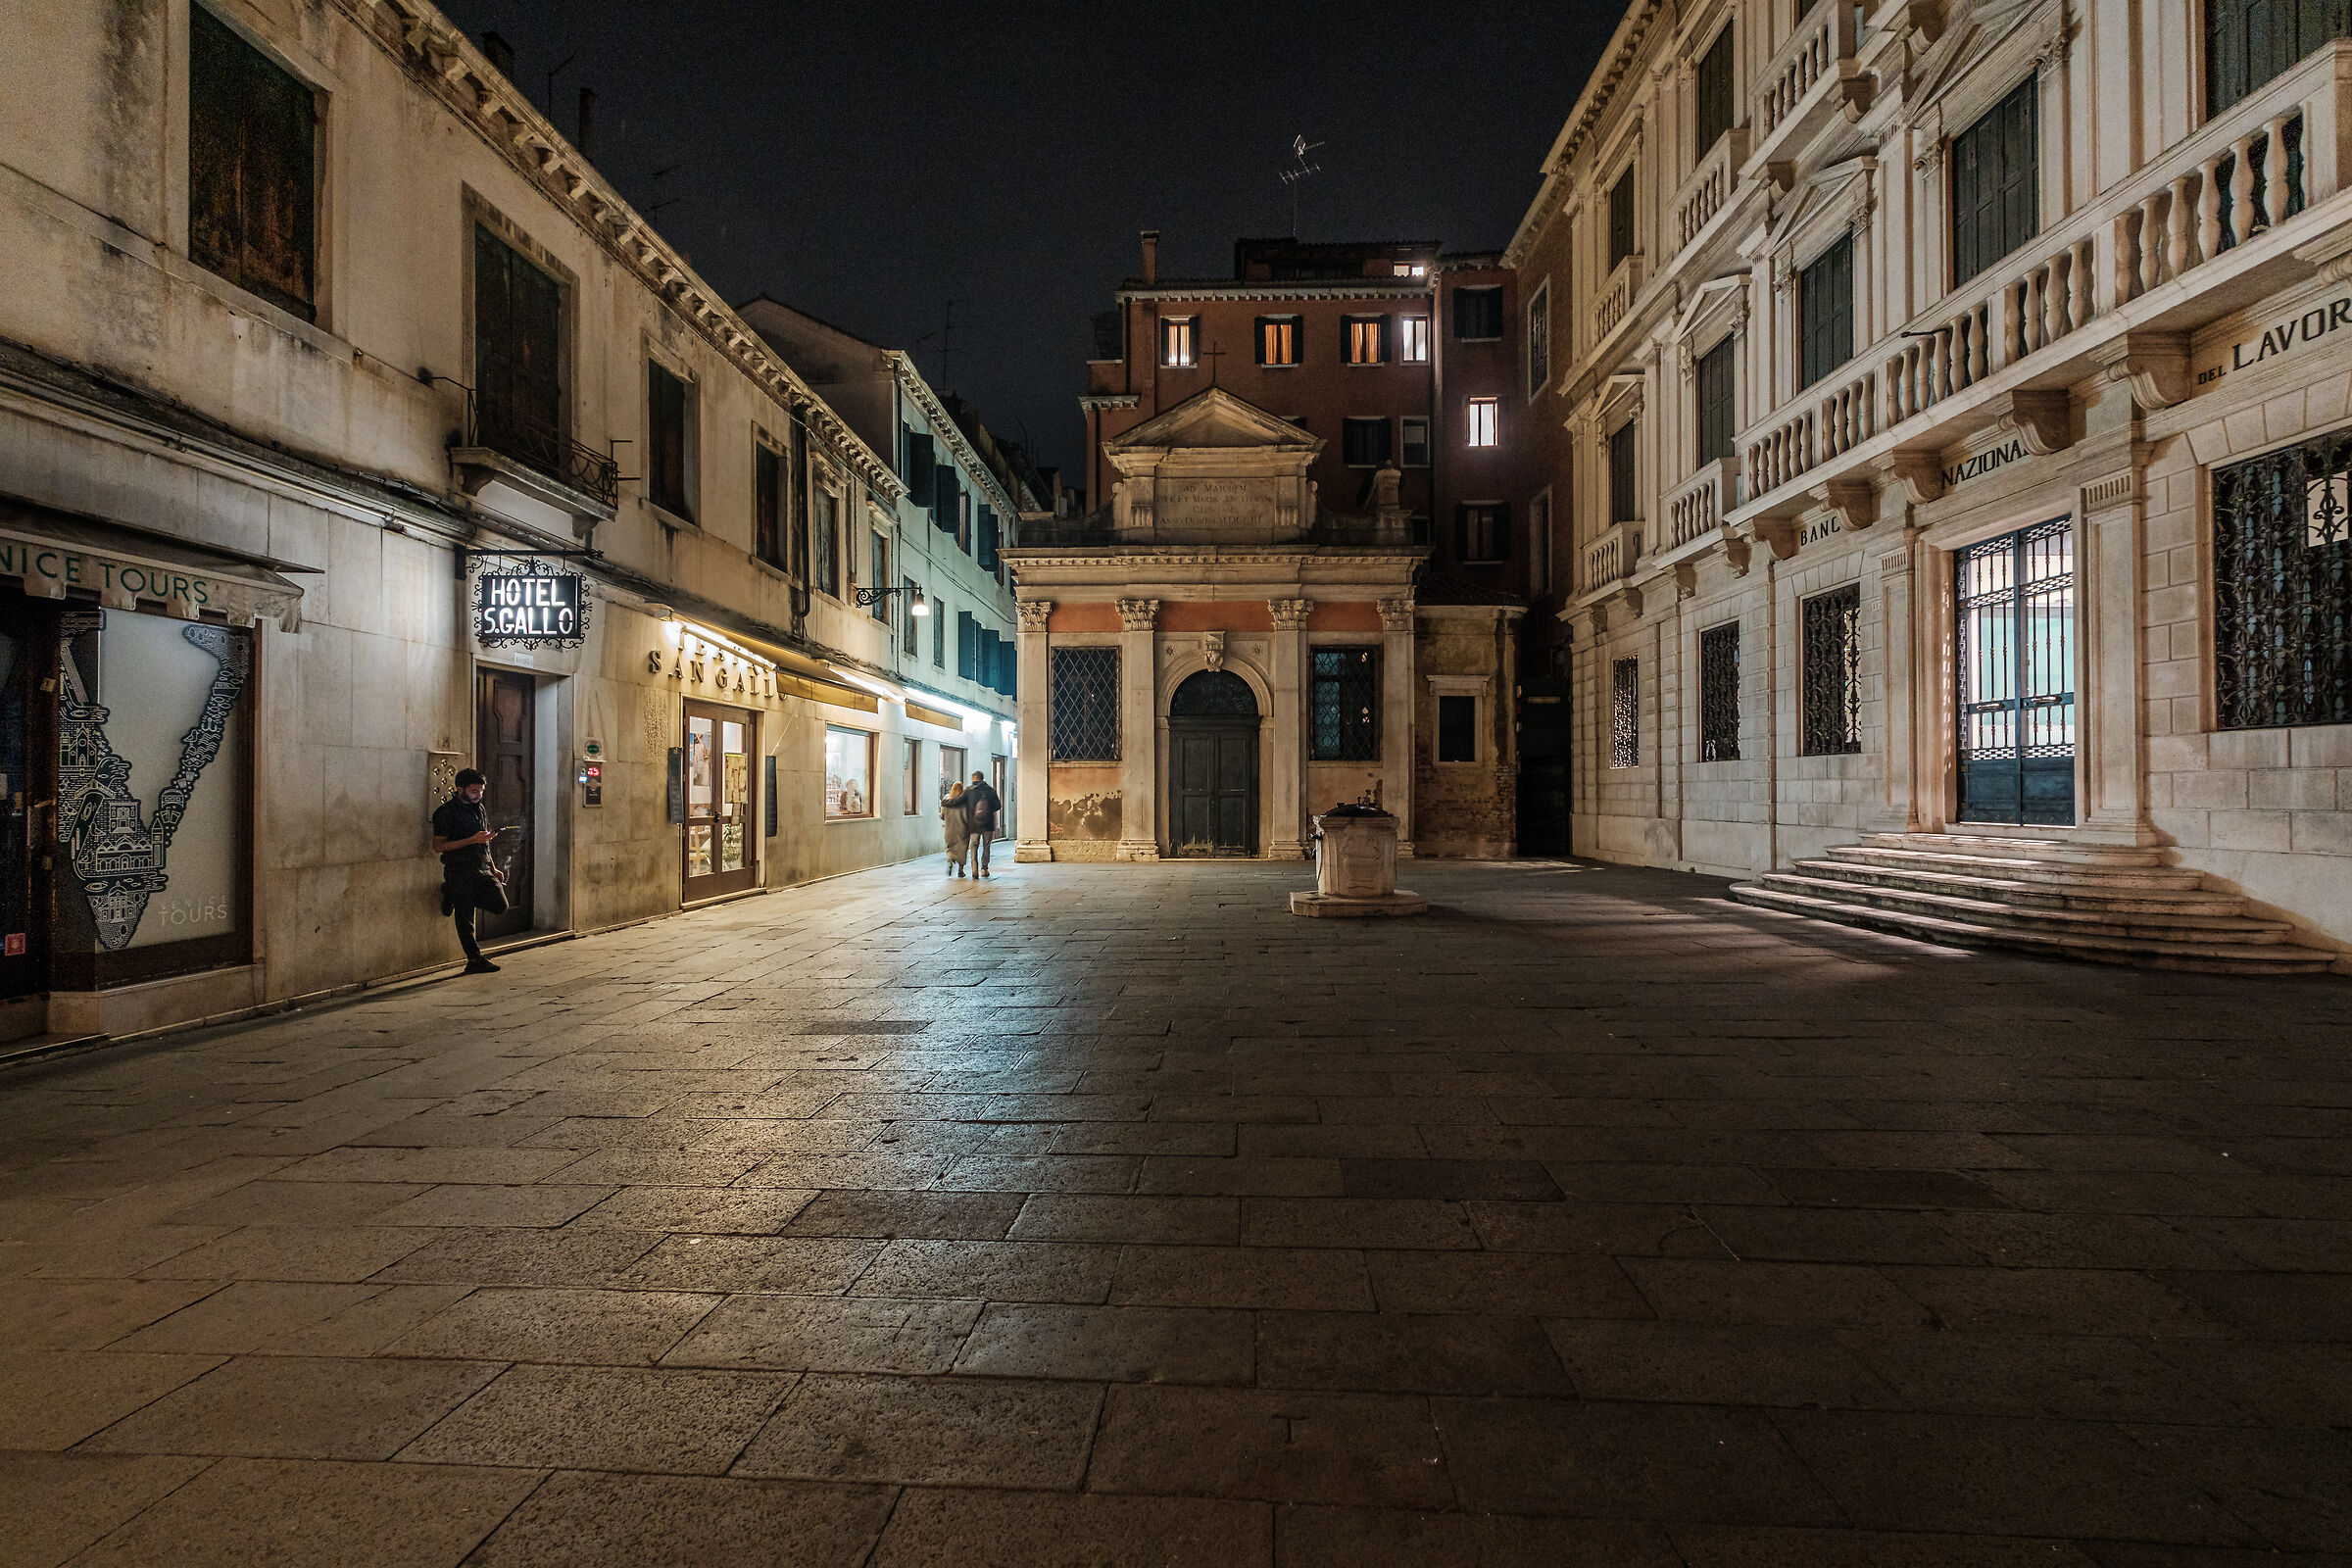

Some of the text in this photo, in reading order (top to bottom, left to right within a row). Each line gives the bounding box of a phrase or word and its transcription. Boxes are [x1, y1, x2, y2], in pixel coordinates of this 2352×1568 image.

[2198, 366, 2227, 385] DEL
[2232, 298, 2352, 371] LAVOR
[100, 563, 208, 604] TOURS
[490, 578, 566, 607] HOTEL
[649, 650, 705, 683] SAN
[158, 904, 227, 926] TOURS
